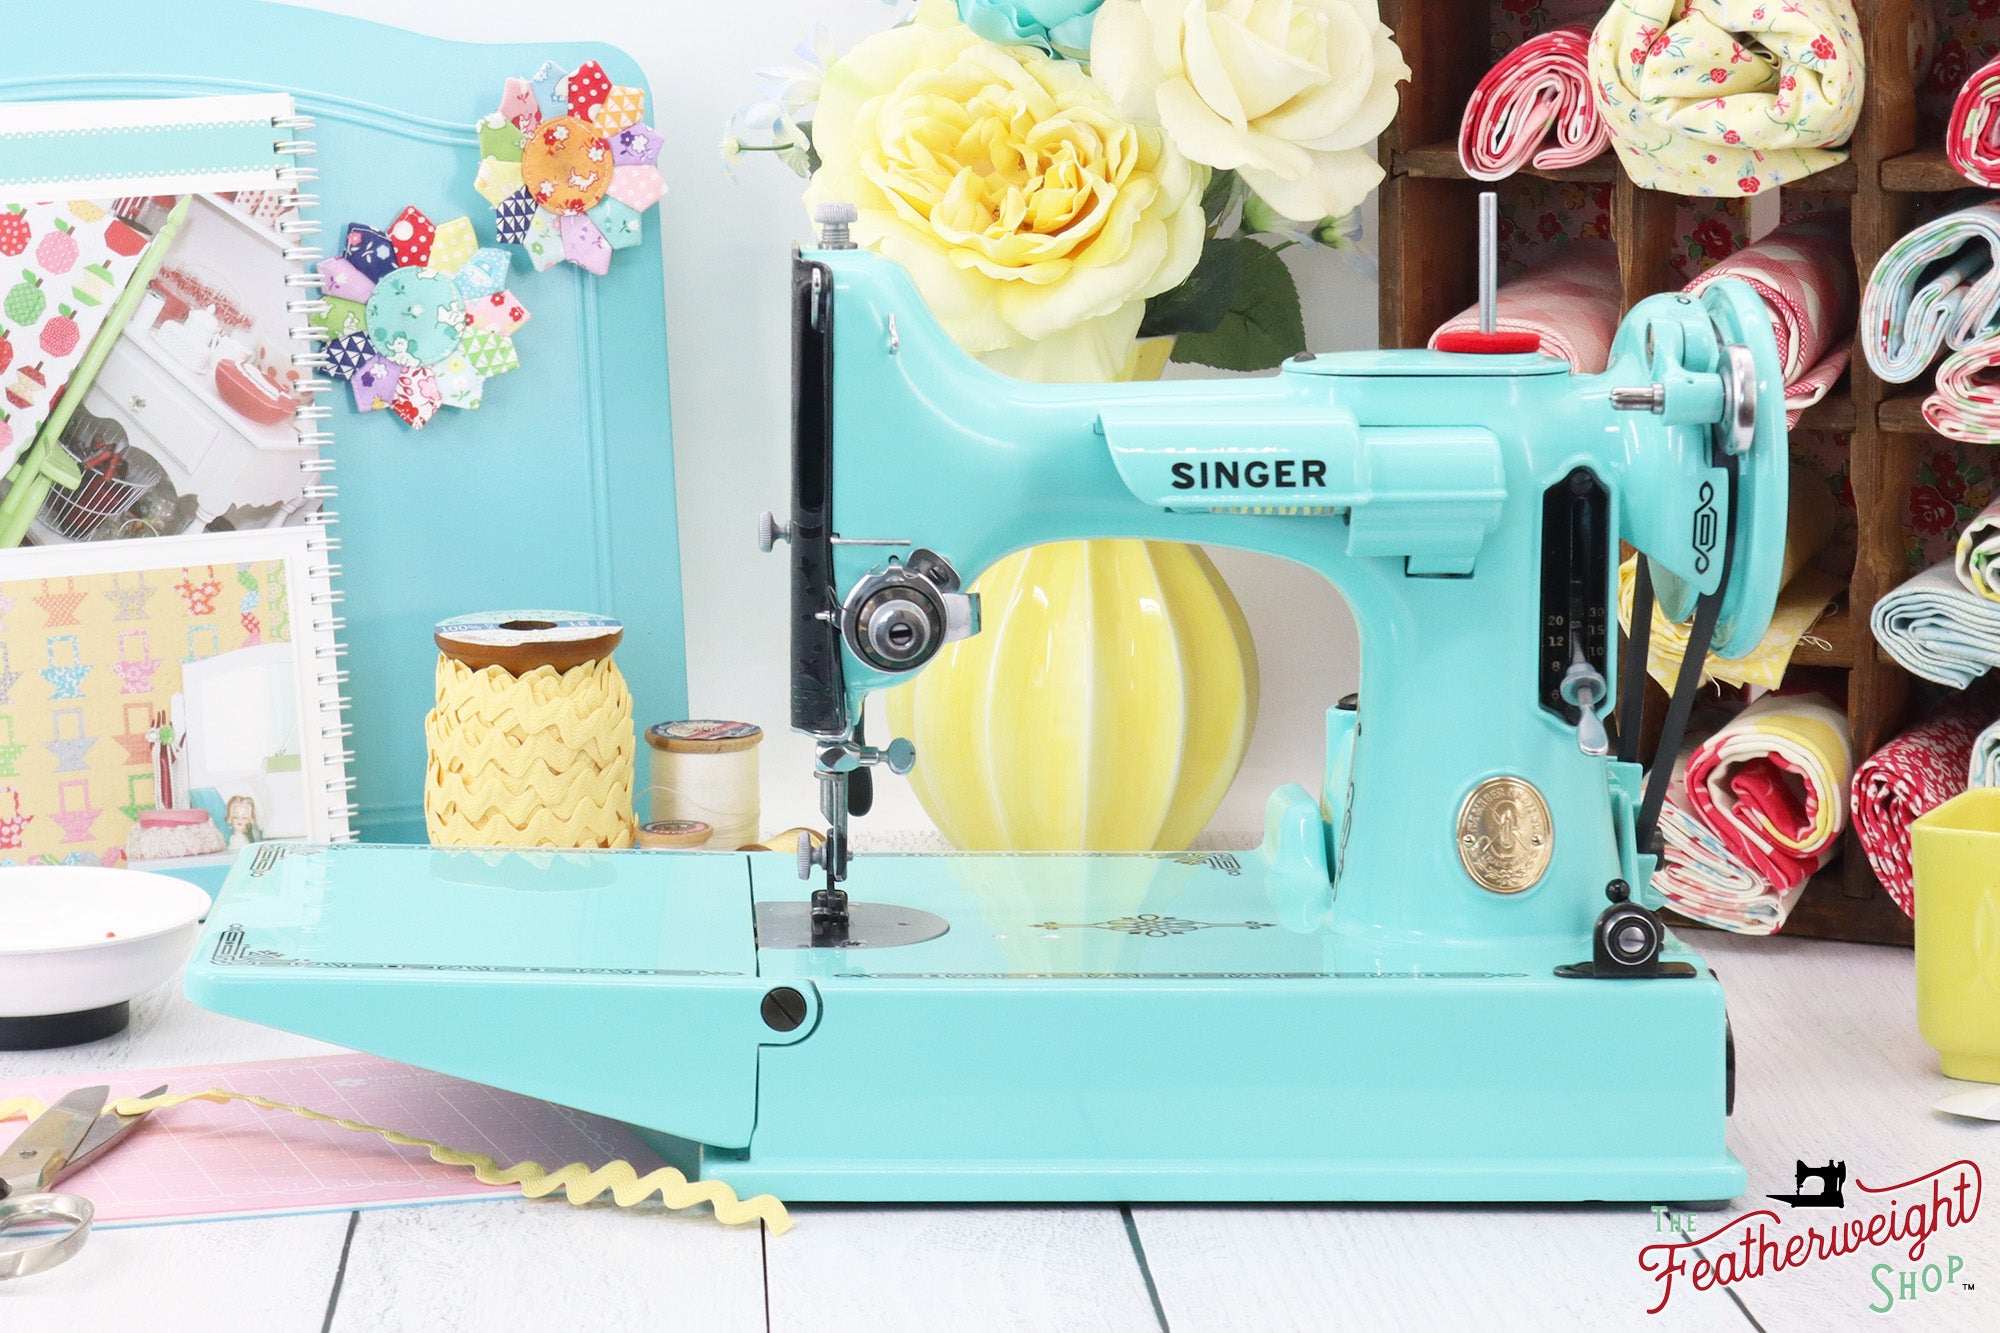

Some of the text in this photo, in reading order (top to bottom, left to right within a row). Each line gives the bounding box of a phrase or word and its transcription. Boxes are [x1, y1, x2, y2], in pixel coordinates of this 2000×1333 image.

[1171, 460, 1327, 490] SINGER
[1589, 607, 1605, 618] 30
[1548, 616, 1564, 626] 20
[1589, 624, 1605, 636] 15
[1548, 636, 1564, 647] 12
[1589, 646, 1604, 657] 10
